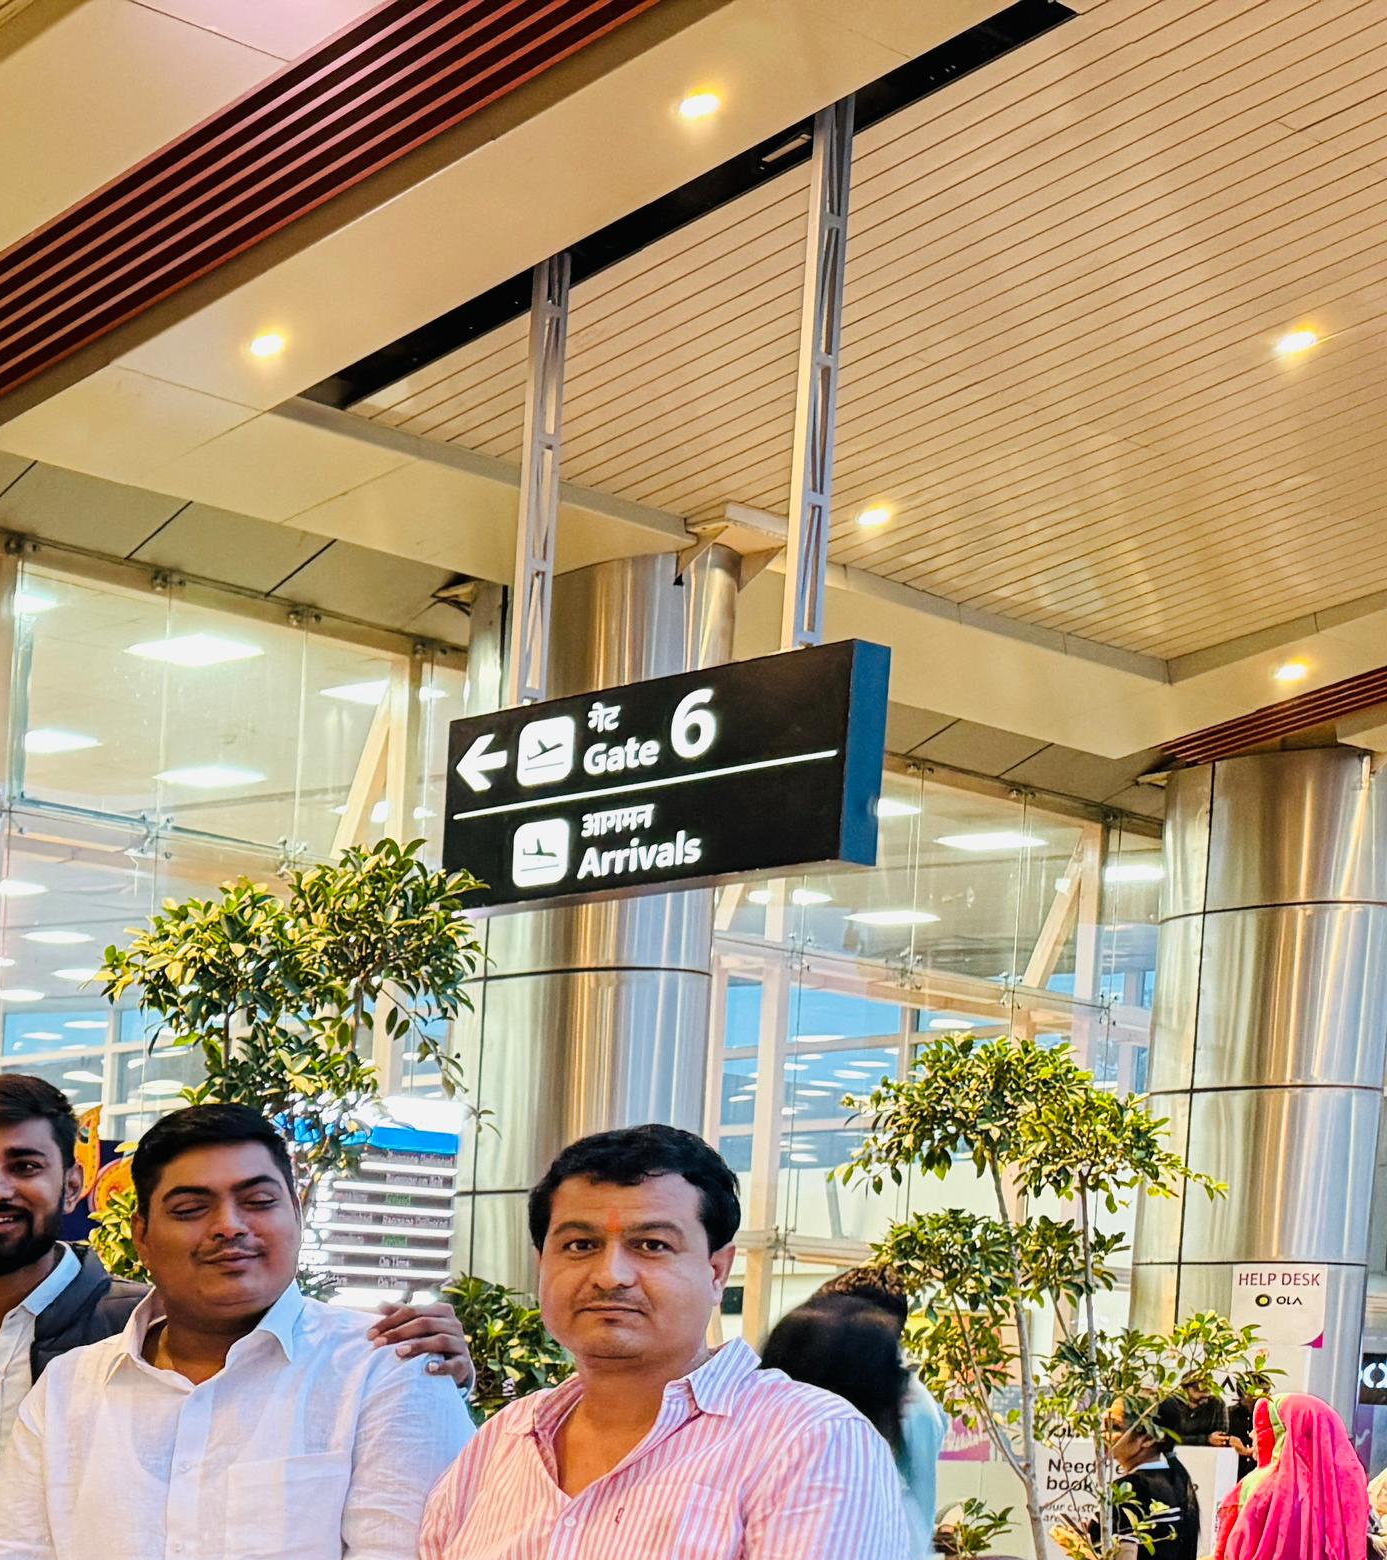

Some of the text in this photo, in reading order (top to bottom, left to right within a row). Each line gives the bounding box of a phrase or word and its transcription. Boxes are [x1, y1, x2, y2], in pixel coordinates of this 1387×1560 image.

[583, 688, 716, 776] Gate 6
[587, 701, 622, 733] गेट
[581, 803, 655, 838] आगमन
[577, 831, 701, 879] Arrivals
[1239, 1273, 1320, 1287] HELP DESK
[1276, 1296, 1303, 1306] OLA
[1048, 1459, 1096, 1474] Need
